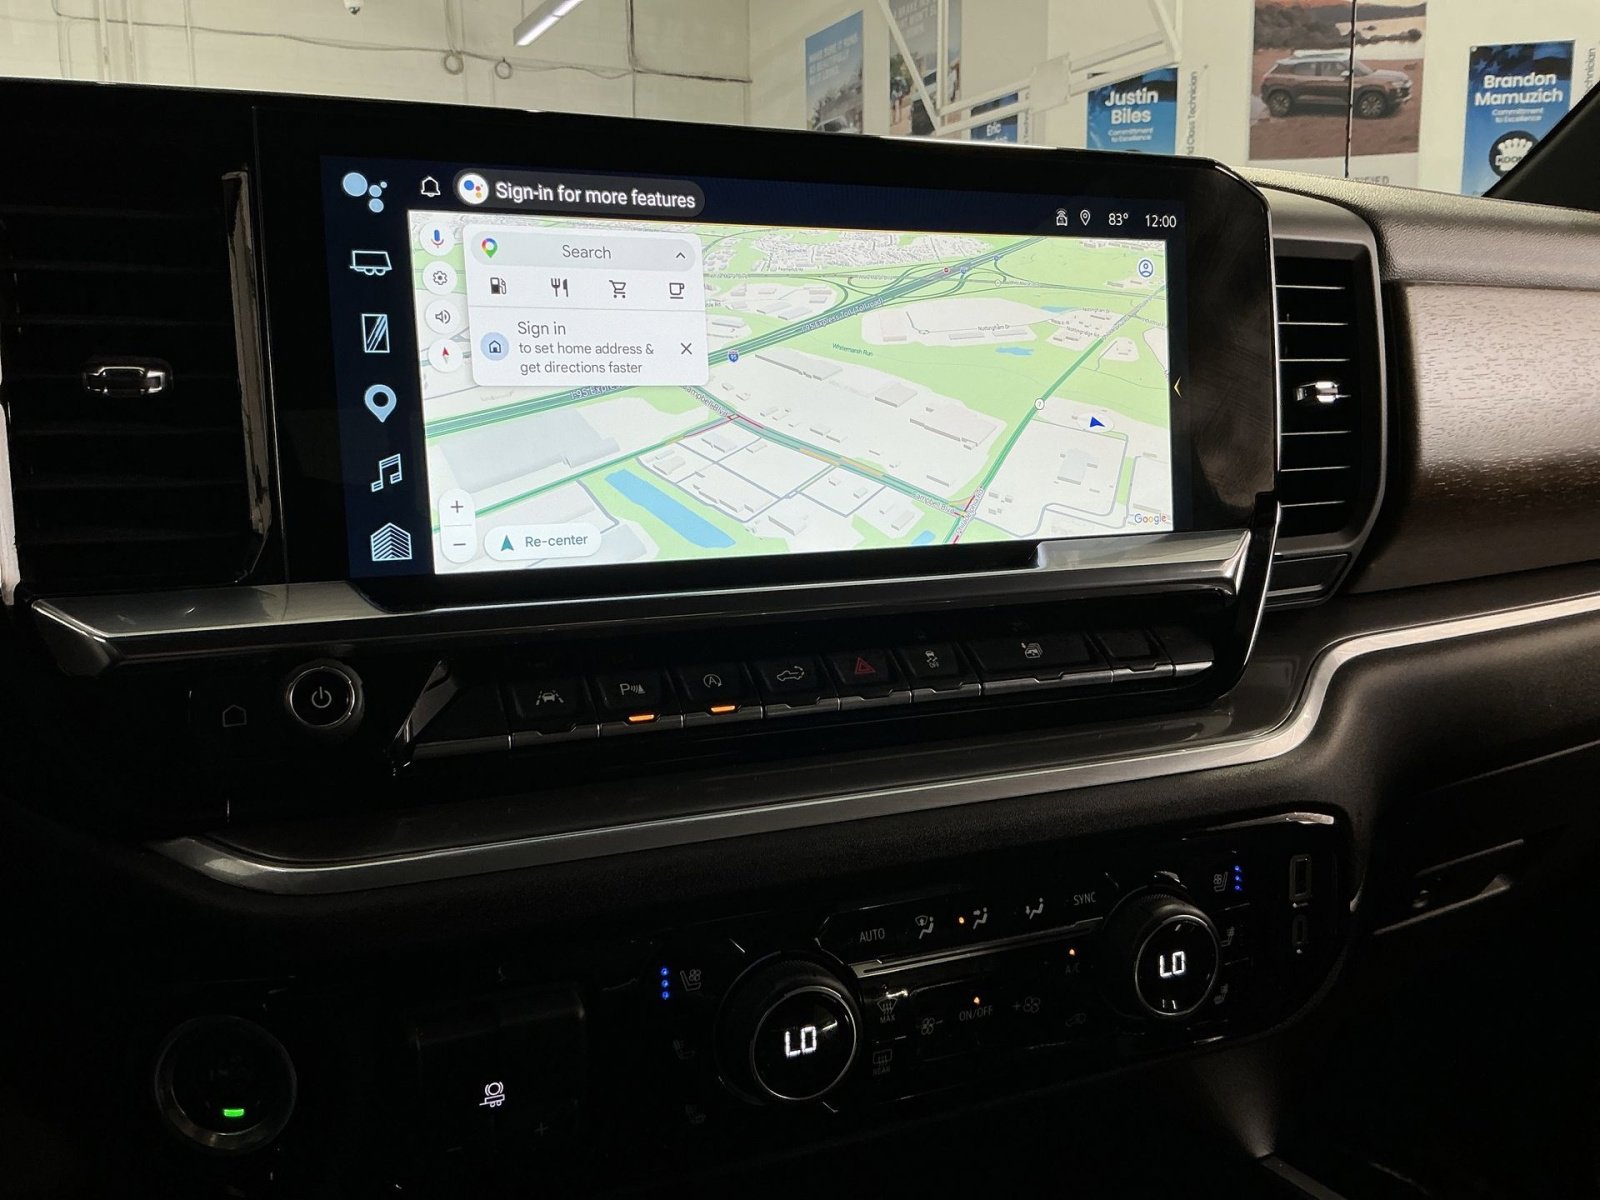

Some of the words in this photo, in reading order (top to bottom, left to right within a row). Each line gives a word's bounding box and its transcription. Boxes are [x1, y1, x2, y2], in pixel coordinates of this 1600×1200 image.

[1483, 72, 1557, 89] Brandon
[1105, 87, 1158, 107] Justin
[1188, 71, 1197, 119] Technician
[1474, 88, 1563, 106] Mamuzich
[1111, 109, 1152, 125] Biles
[987, 122, 1001, 136] Eric
[496, 181, 554, 203] Sign-in
[558, 184, 582, 202] for
[586, 189, 628, 205] more
[631, 187, 696, 208] features
[1108, 213, 1129, 226] 83°
[1145, 214, 1177, 228] 12:00
[562, 244, 612, 260] Search
[517, 321, 548, 338] Sign
[553, 322, 566, 335] in
[519, 343, 531, 354] to
[535, 343, 554, 354] set
[557, 343, 591, 355] home
[595, 343, 642, 355] address
[645, 344, 654, 355] &
[520, 363, 542, 375] get
[545, 361, 605, 374] directions
[608, 361, 643, 373] faster
[1134, 513, 1167, 526] Google
[525, 535, 588, 548] Re-center
[1073, 891, 1096, 906] SYNC
[859, 928, 886, 943] AUTO
[959, 1006, 993, 1021] ON/OFF
